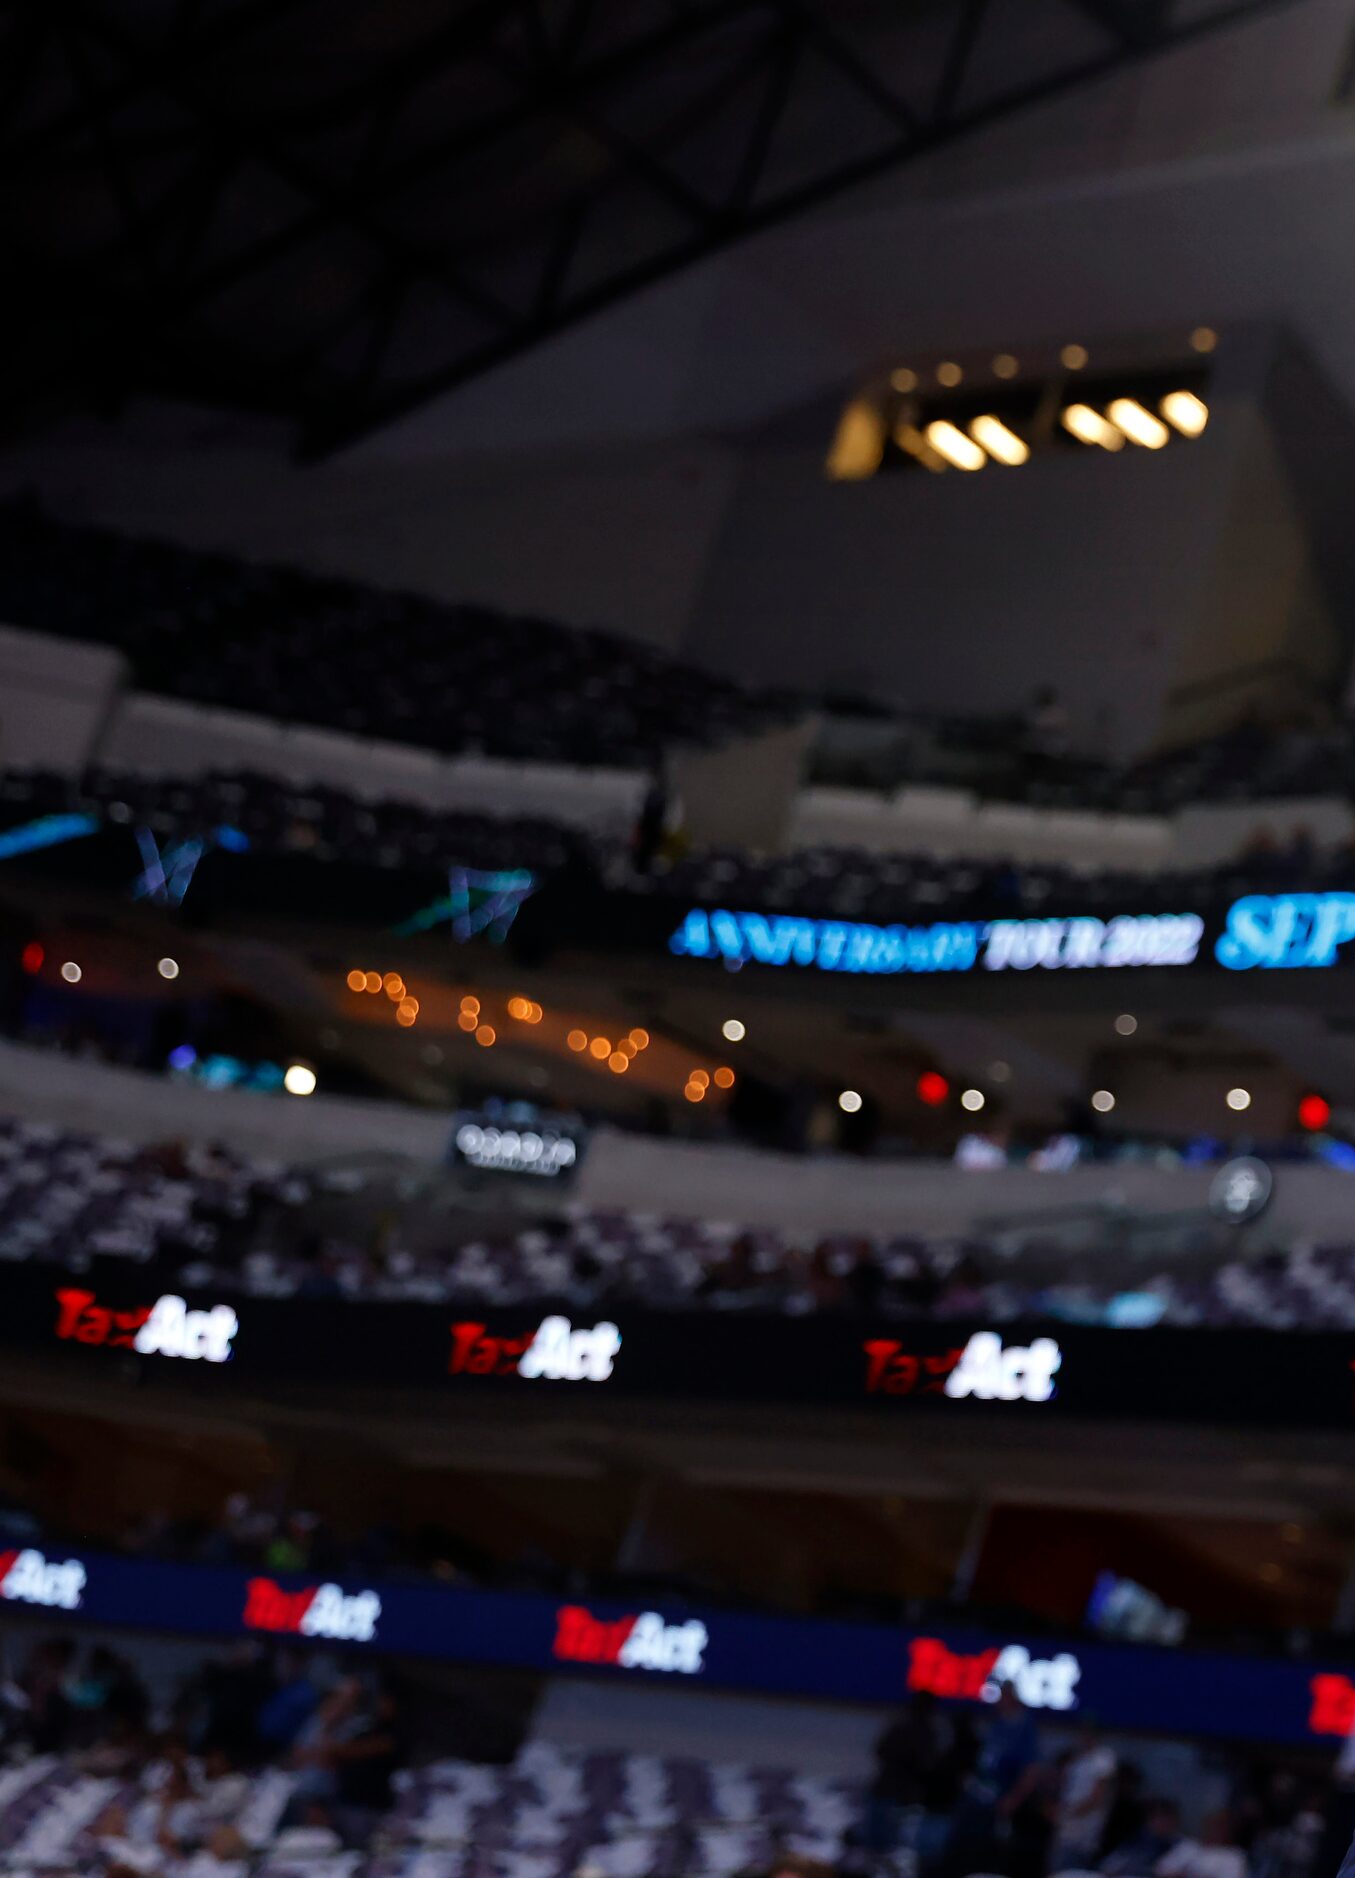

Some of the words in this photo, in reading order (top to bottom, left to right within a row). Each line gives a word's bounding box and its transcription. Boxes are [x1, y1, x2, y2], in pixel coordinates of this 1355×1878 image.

[56, 1287, 239, 1362] TaxAct
[450, 1314, 621, 1382] TaxAct
[864, 1330, 1062, 1402] TaxAct
[552, 1604, 707, 1674] TaxAct
